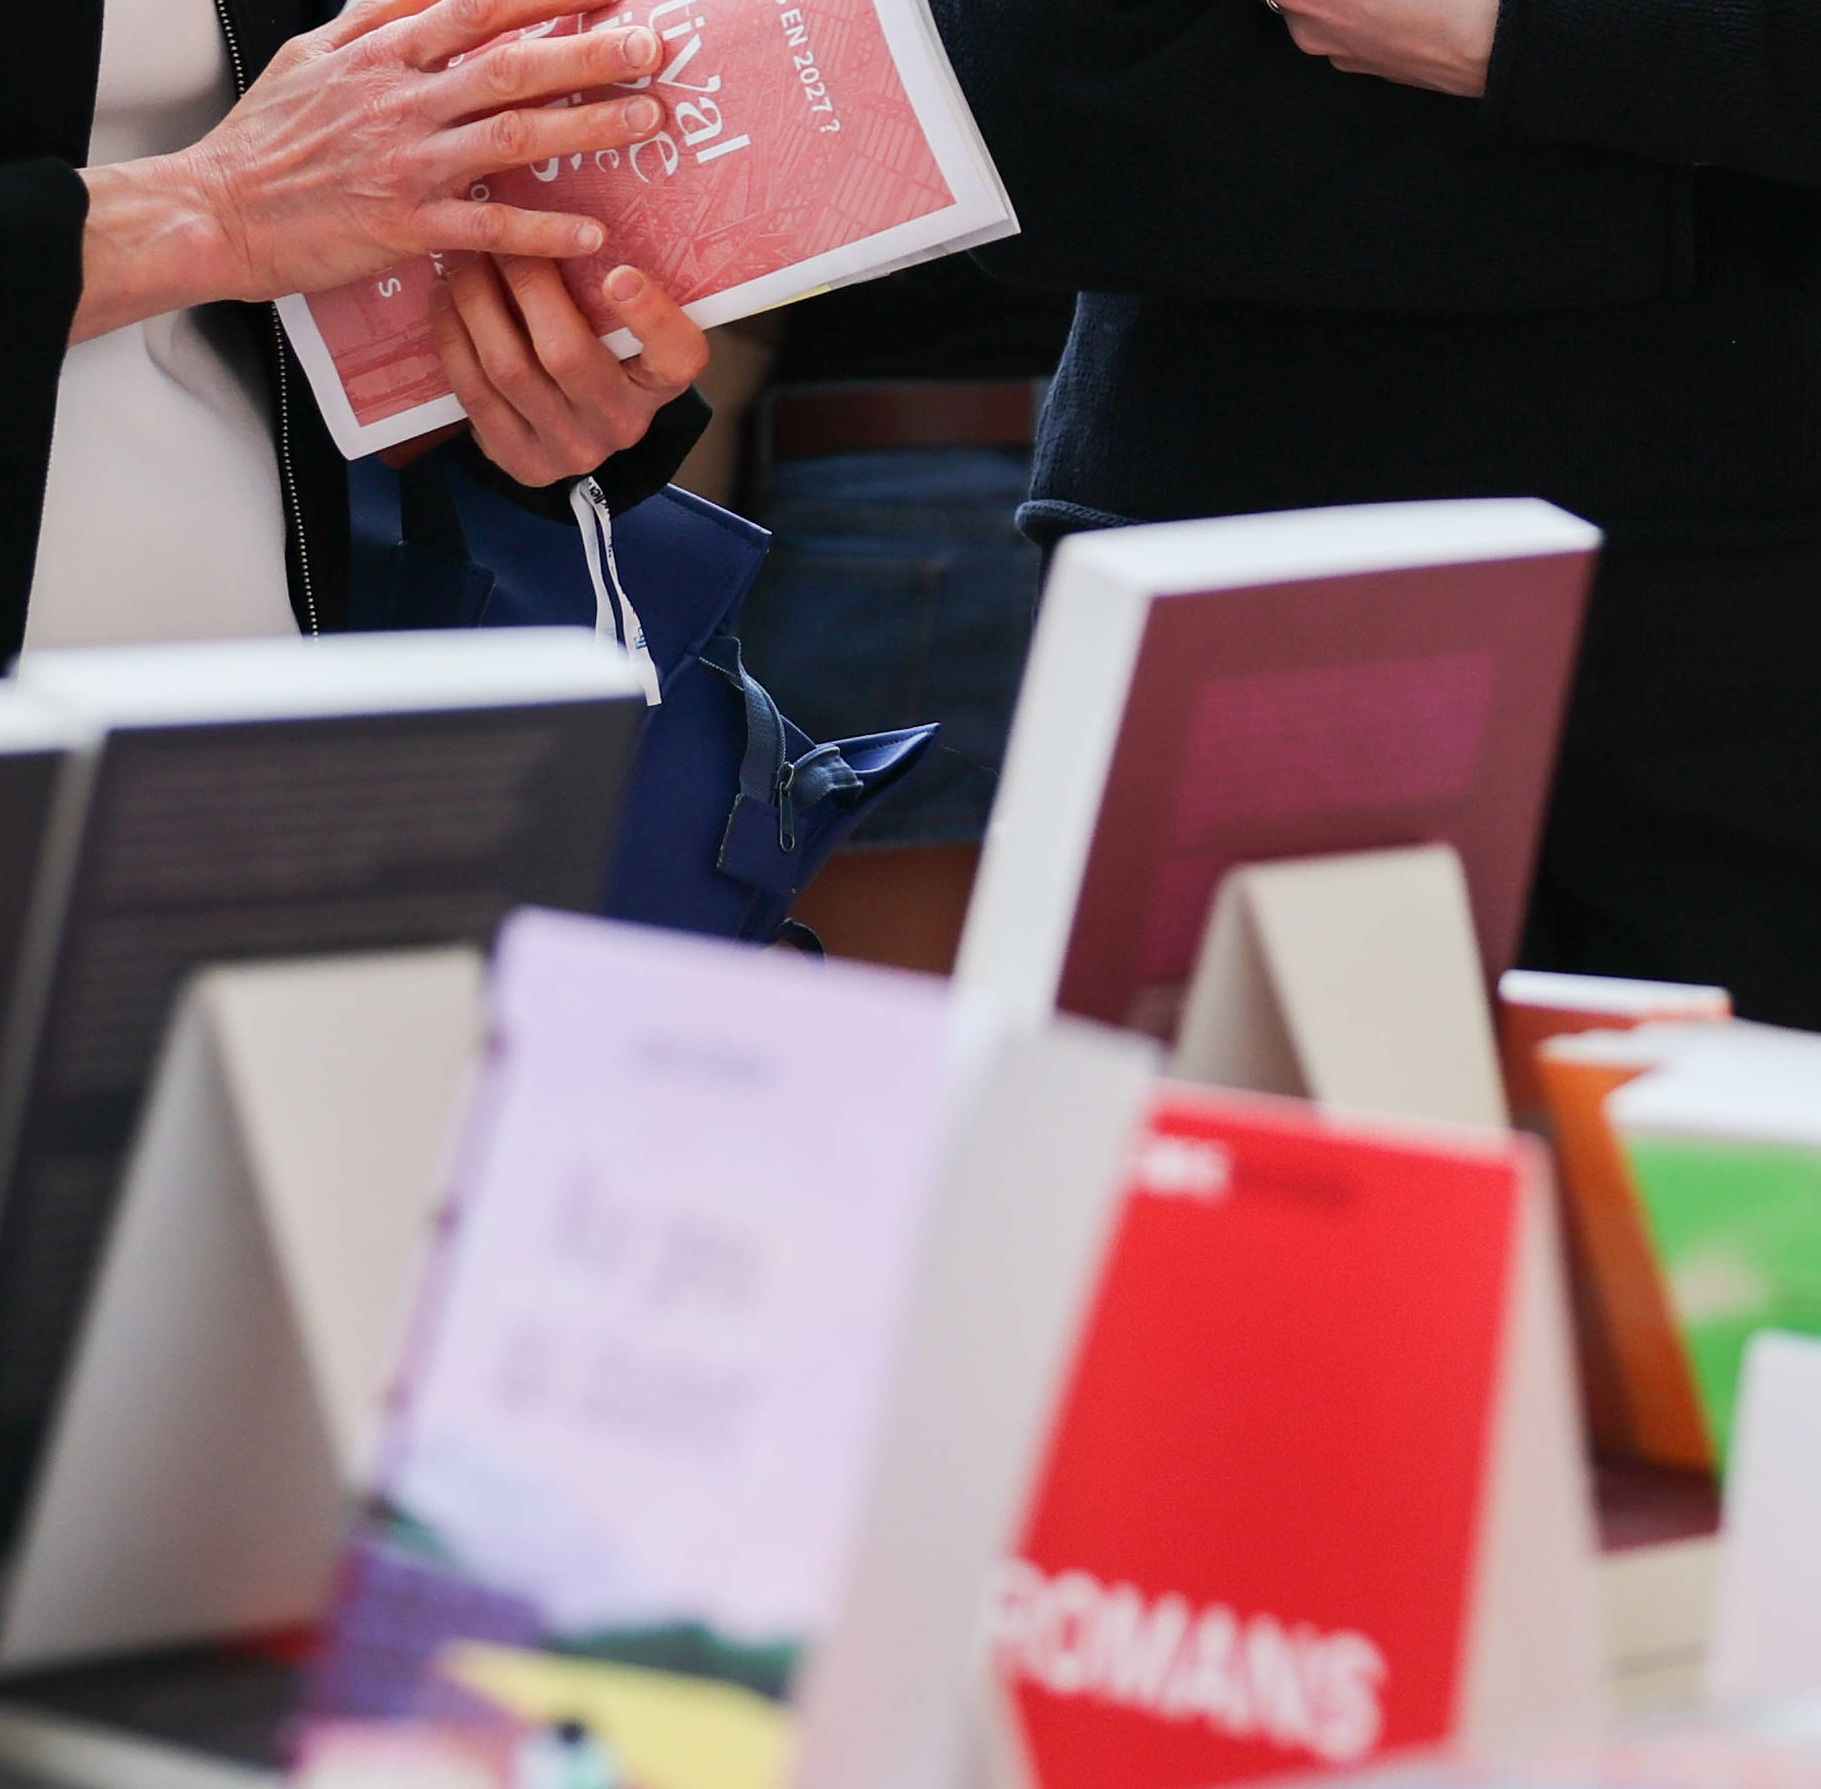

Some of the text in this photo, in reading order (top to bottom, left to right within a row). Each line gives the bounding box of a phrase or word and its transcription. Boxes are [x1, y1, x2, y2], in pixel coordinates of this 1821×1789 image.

[781, 8, 808, 47] EN
[794, 51, 833, 113] 2027
[820, 119, 842, 134] ?
